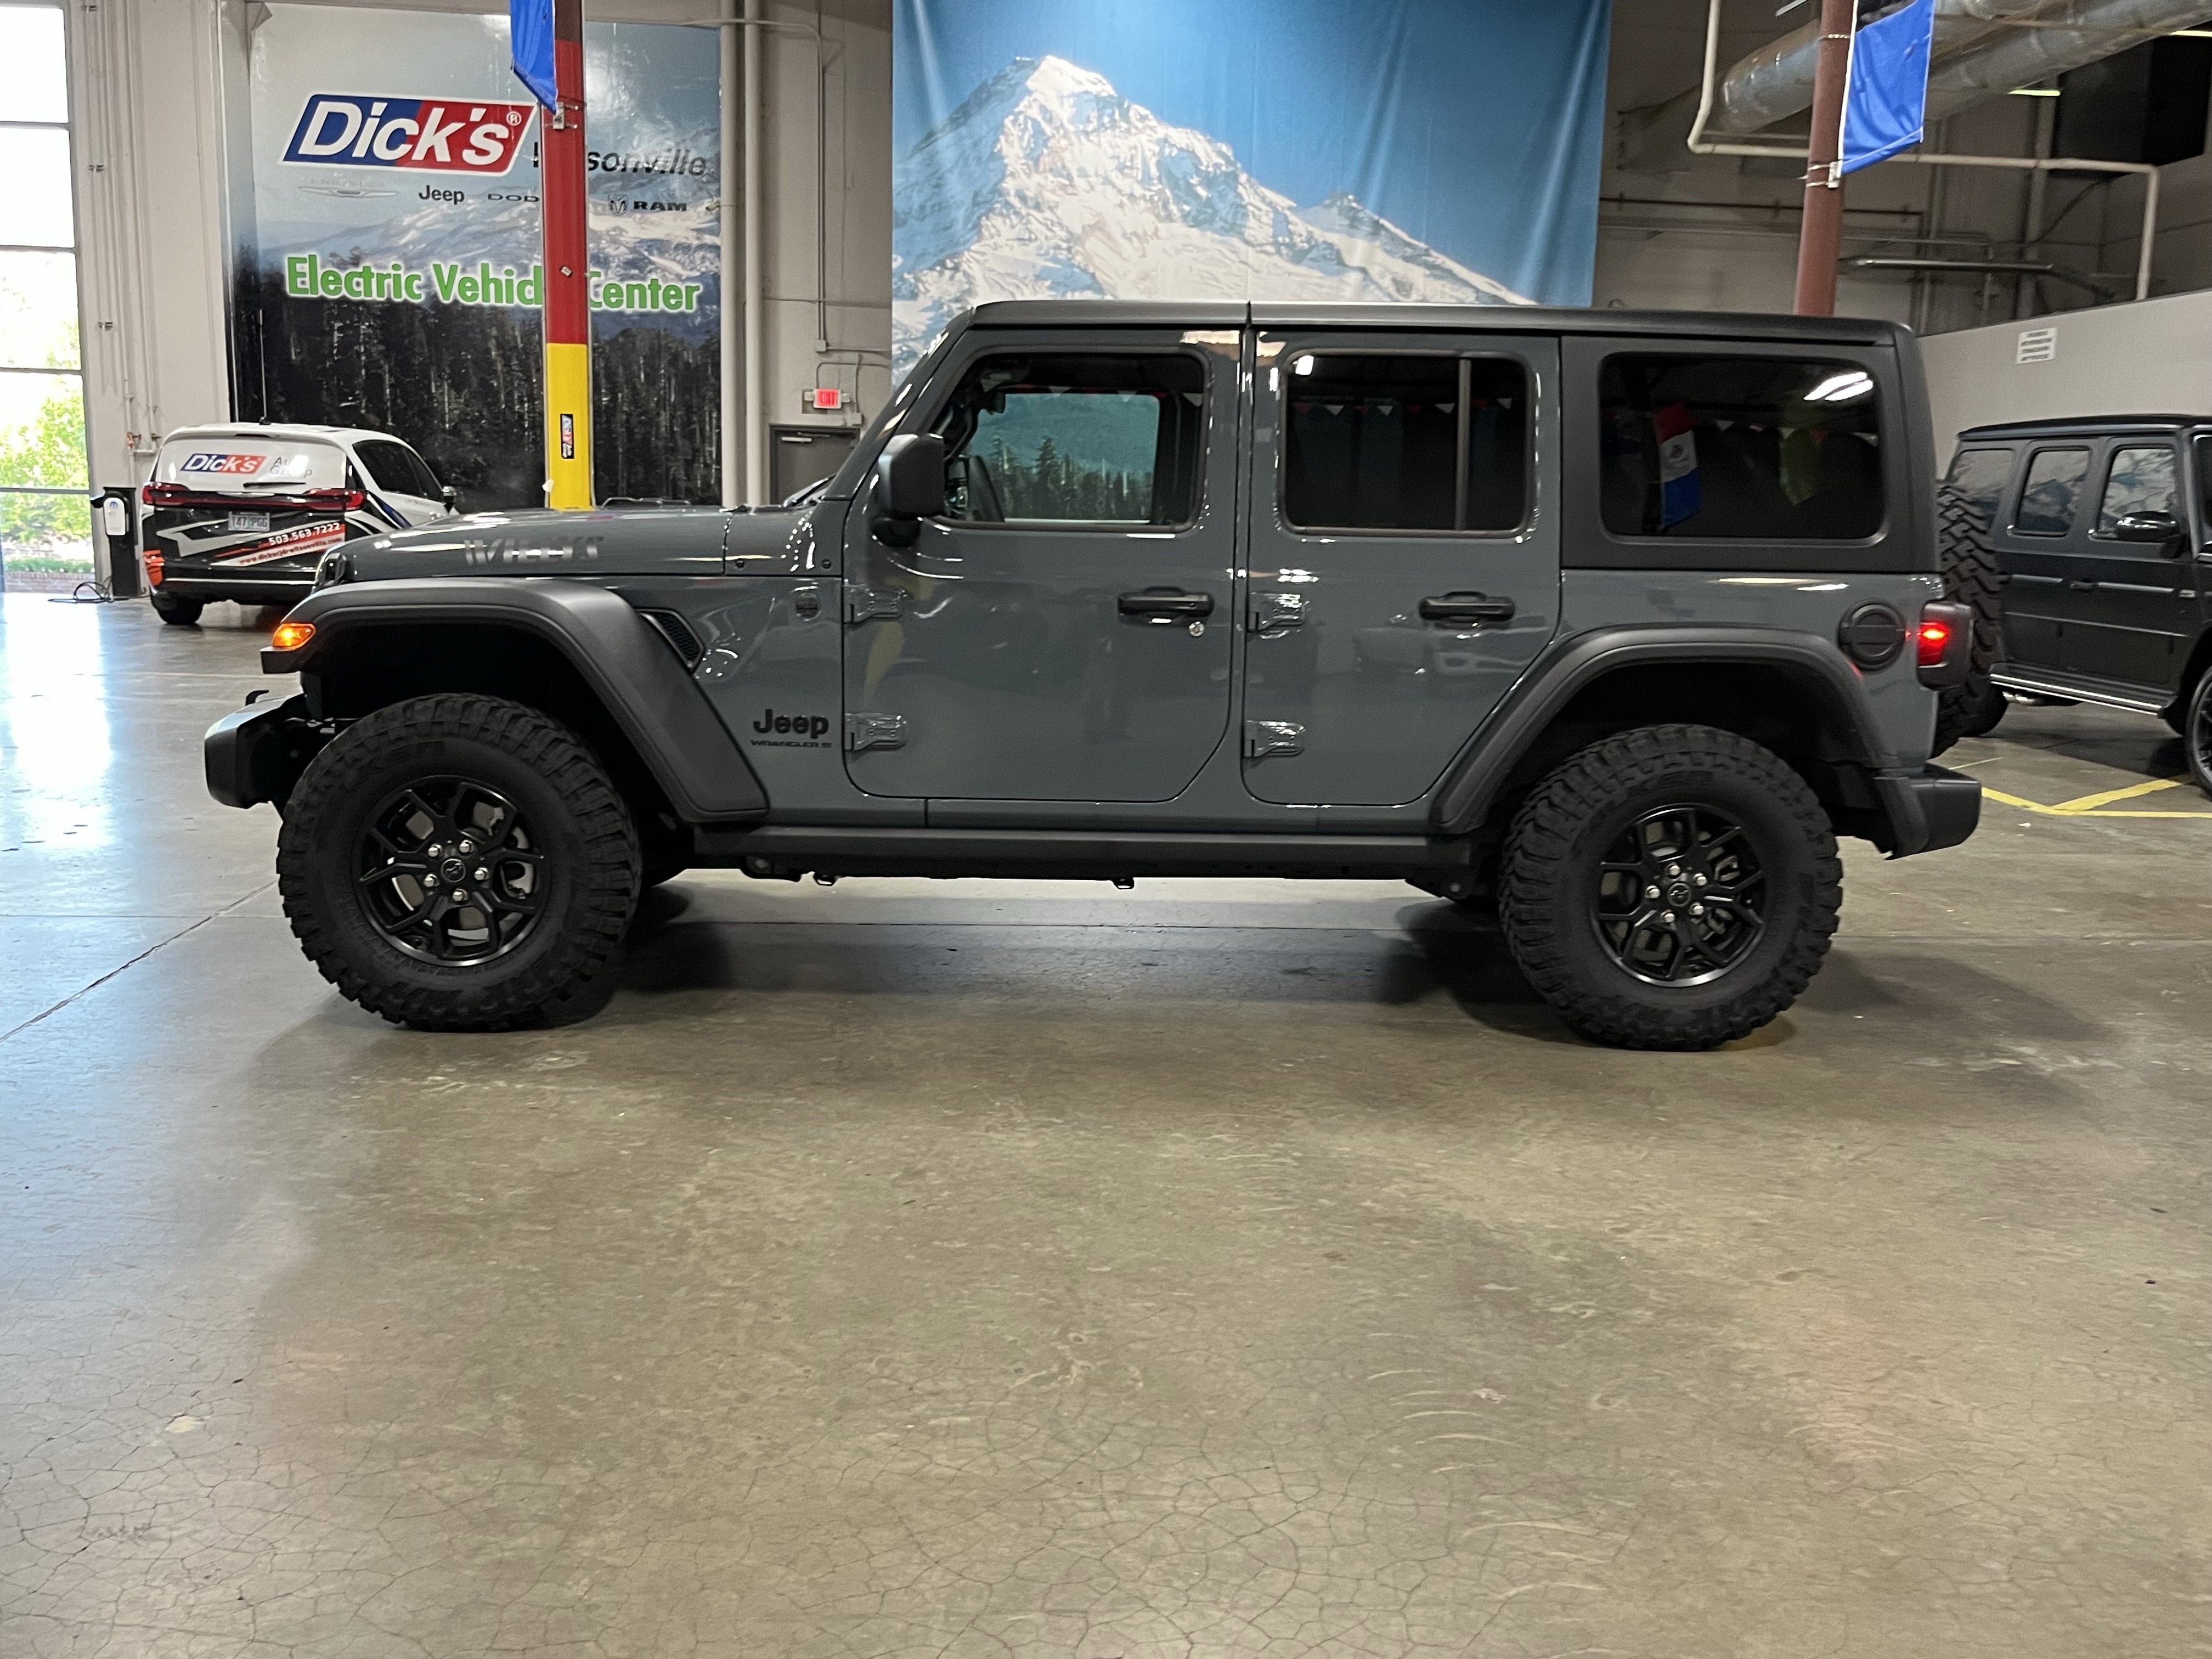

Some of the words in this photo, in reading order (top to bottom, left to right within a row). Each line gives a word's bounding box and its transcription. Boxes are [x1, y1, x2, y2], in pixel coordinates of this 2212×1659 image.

[419, 184, 465, 204] Jeep
[487, 193, 539, 202] DOD
[633, 200, 687, 212] RAM
[287, 254, 422, 301] Electric
[432, 263, 542, 305] Vehicl
[270, 465, 313, 478] Grp
[268, 522, 341, 546] 503.563.7222
[752, 708, 829, 740] Jeep
